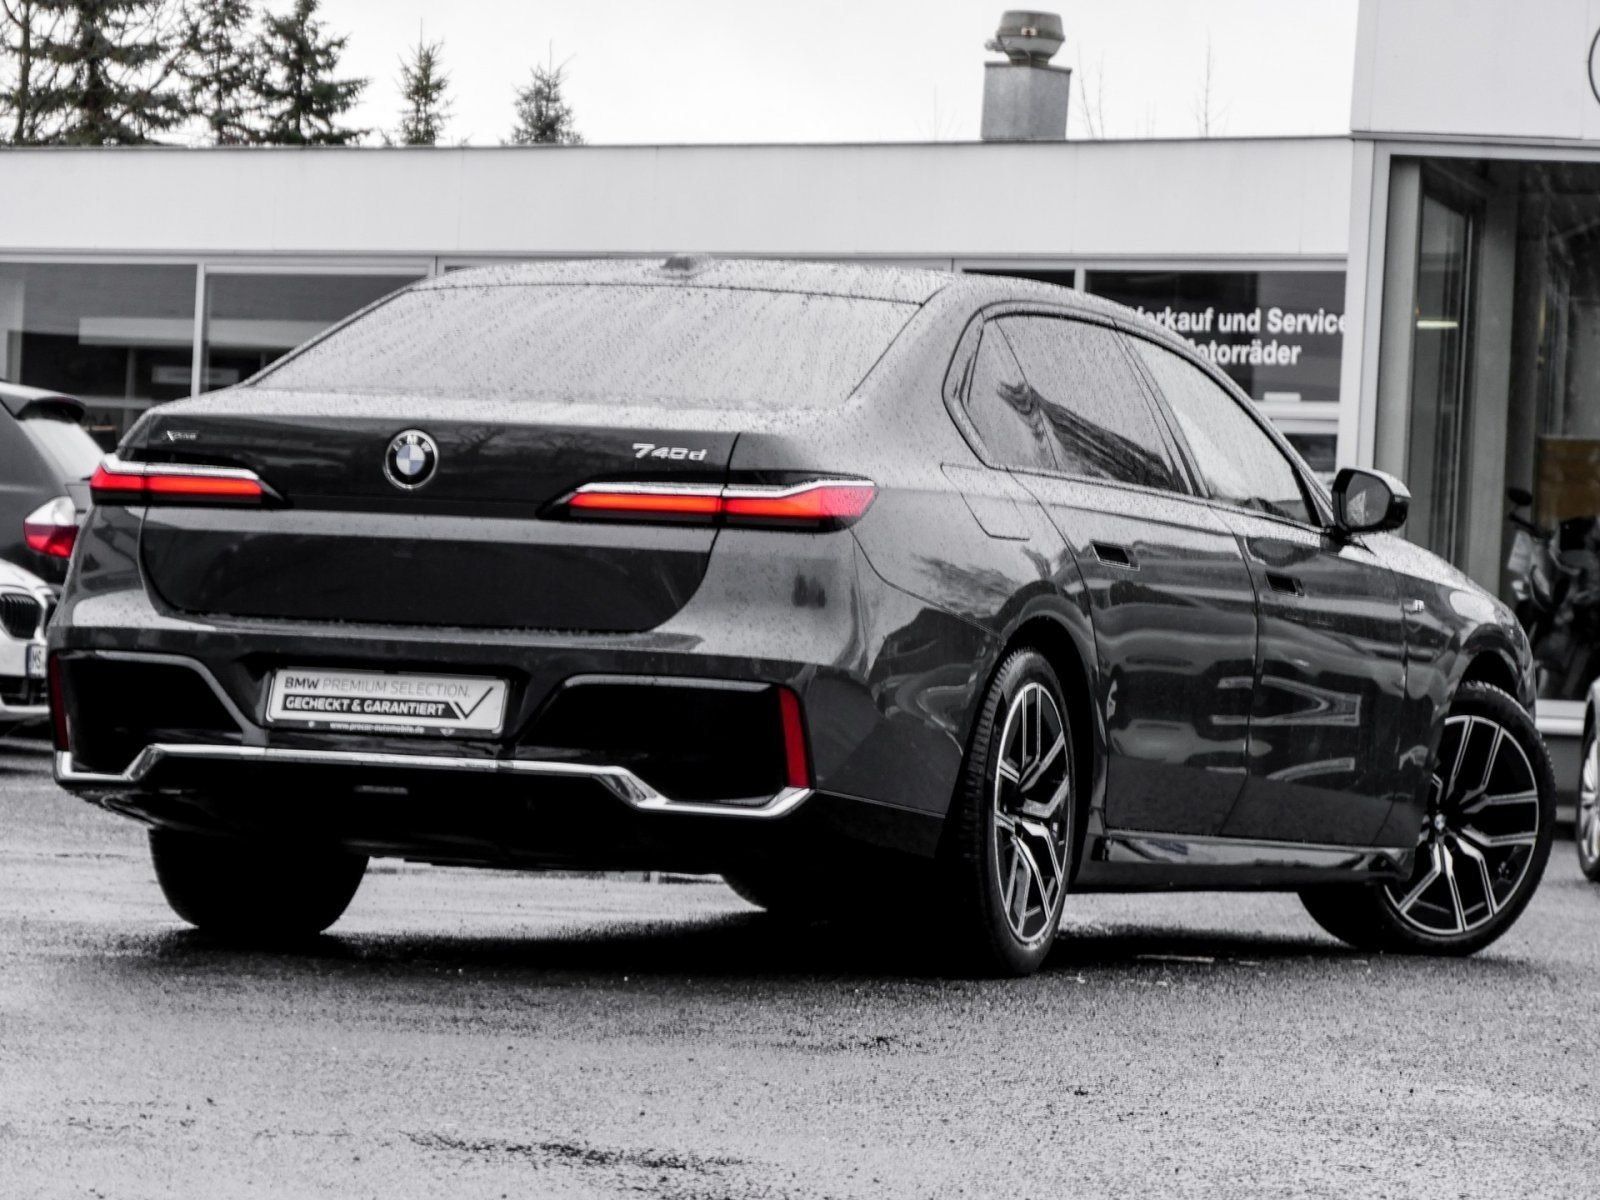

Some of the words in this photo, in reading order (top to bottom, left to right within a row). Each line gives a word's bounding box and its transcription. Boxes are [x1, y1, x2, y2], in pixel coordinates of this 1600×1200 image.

[1136, 306, 1214, 332] rkauf
[1218, 307, 1261, 332] und
[1188, 338, 1302, 364] otorräder
[632, 443, 707, 461] 740d
[284, 676, 320, 690] BMW
[322, 678, 387, 695] PREMIUM
[285, 696, 350, 711] GECHECKT
[351, 700, 361, 712] &
[364, 701, 445, 716] GARANTIERT
